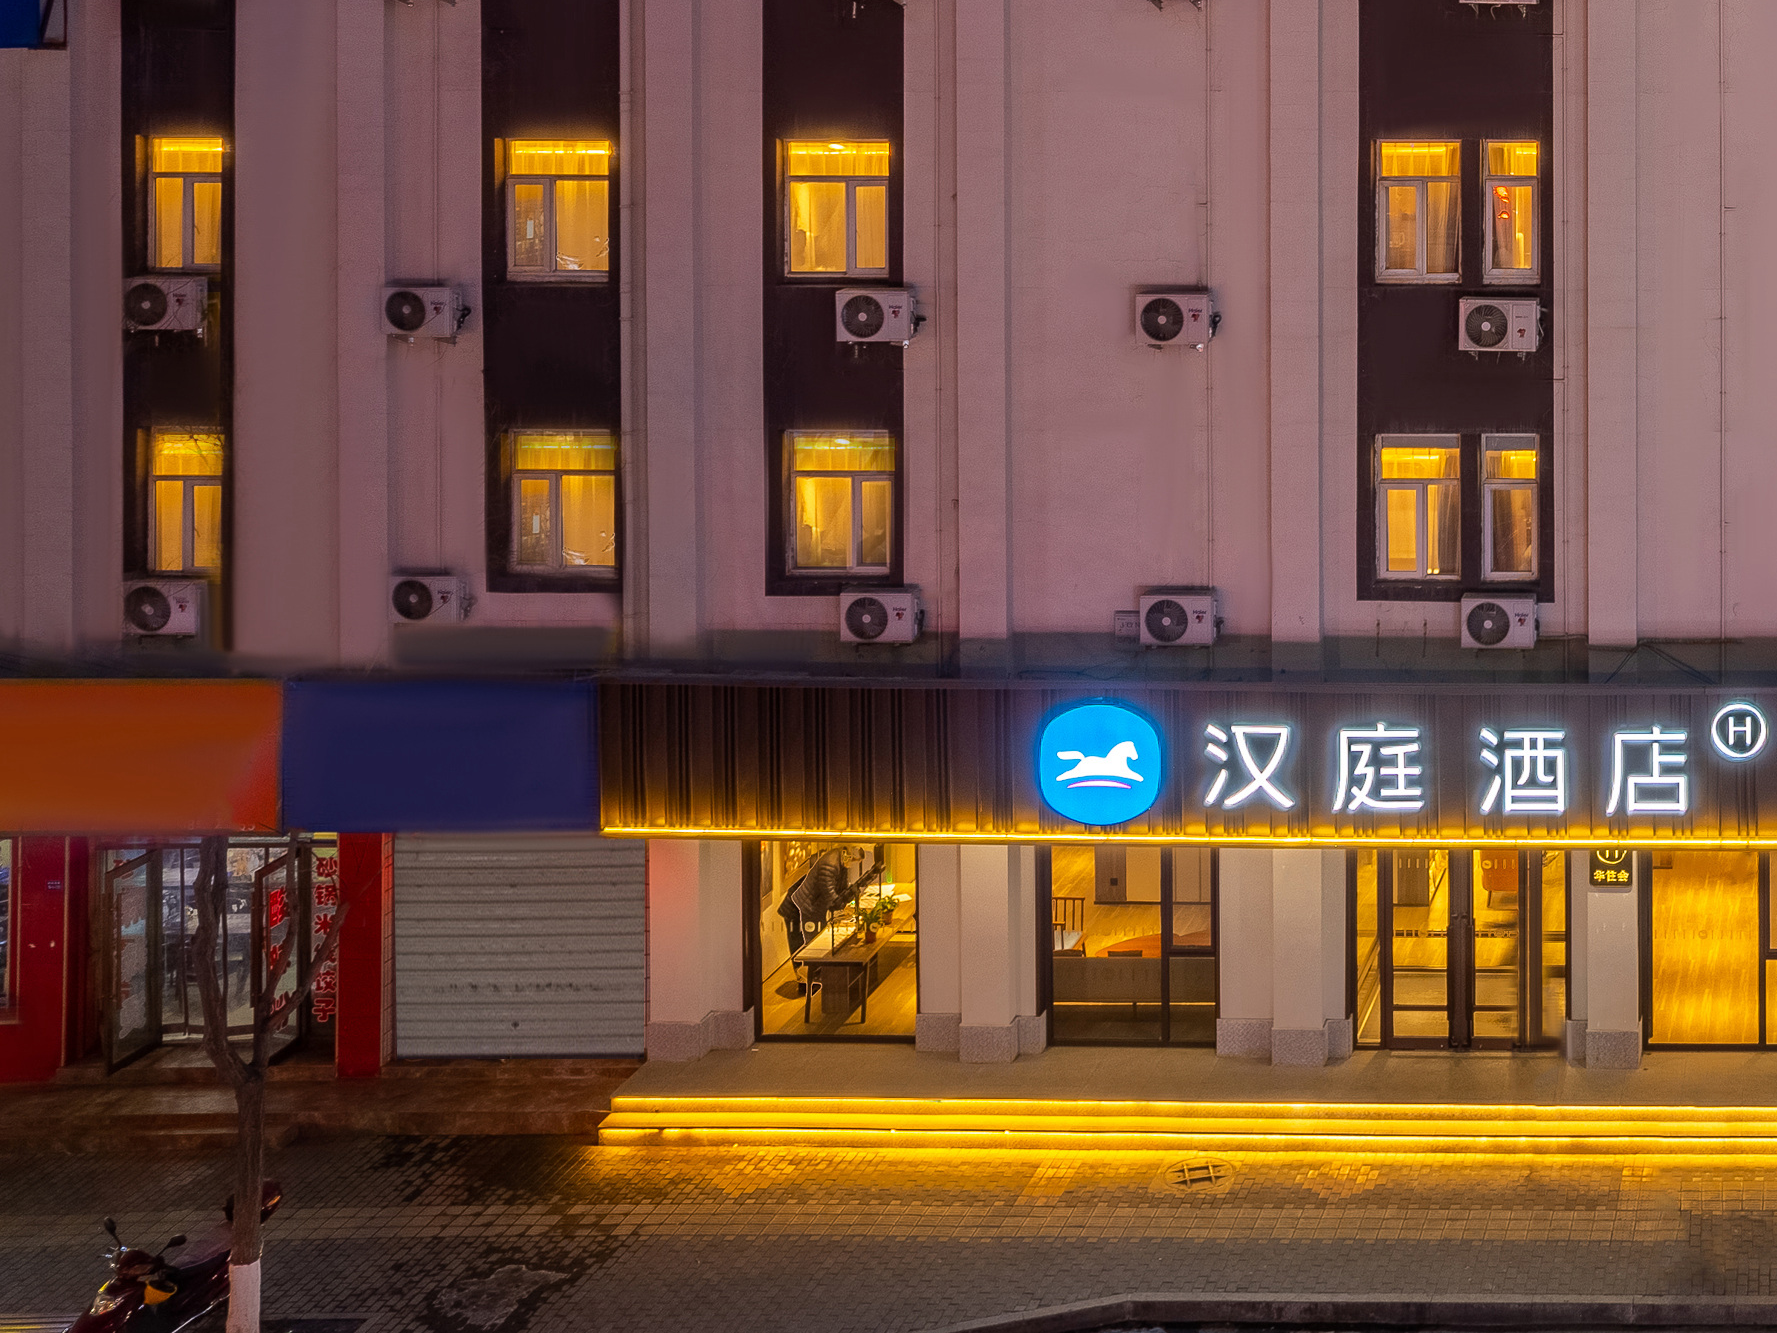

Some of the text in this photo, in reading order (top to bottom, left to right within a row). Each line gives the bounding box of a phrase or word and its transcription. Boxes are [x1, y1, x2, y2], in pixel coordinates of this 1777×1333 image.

[1204, 723, 1688, 816] 汉庭酒店
[1593, 869, 1630, 882] 华住会
[312, 856, 338, 1023] 砂锅米饺子
